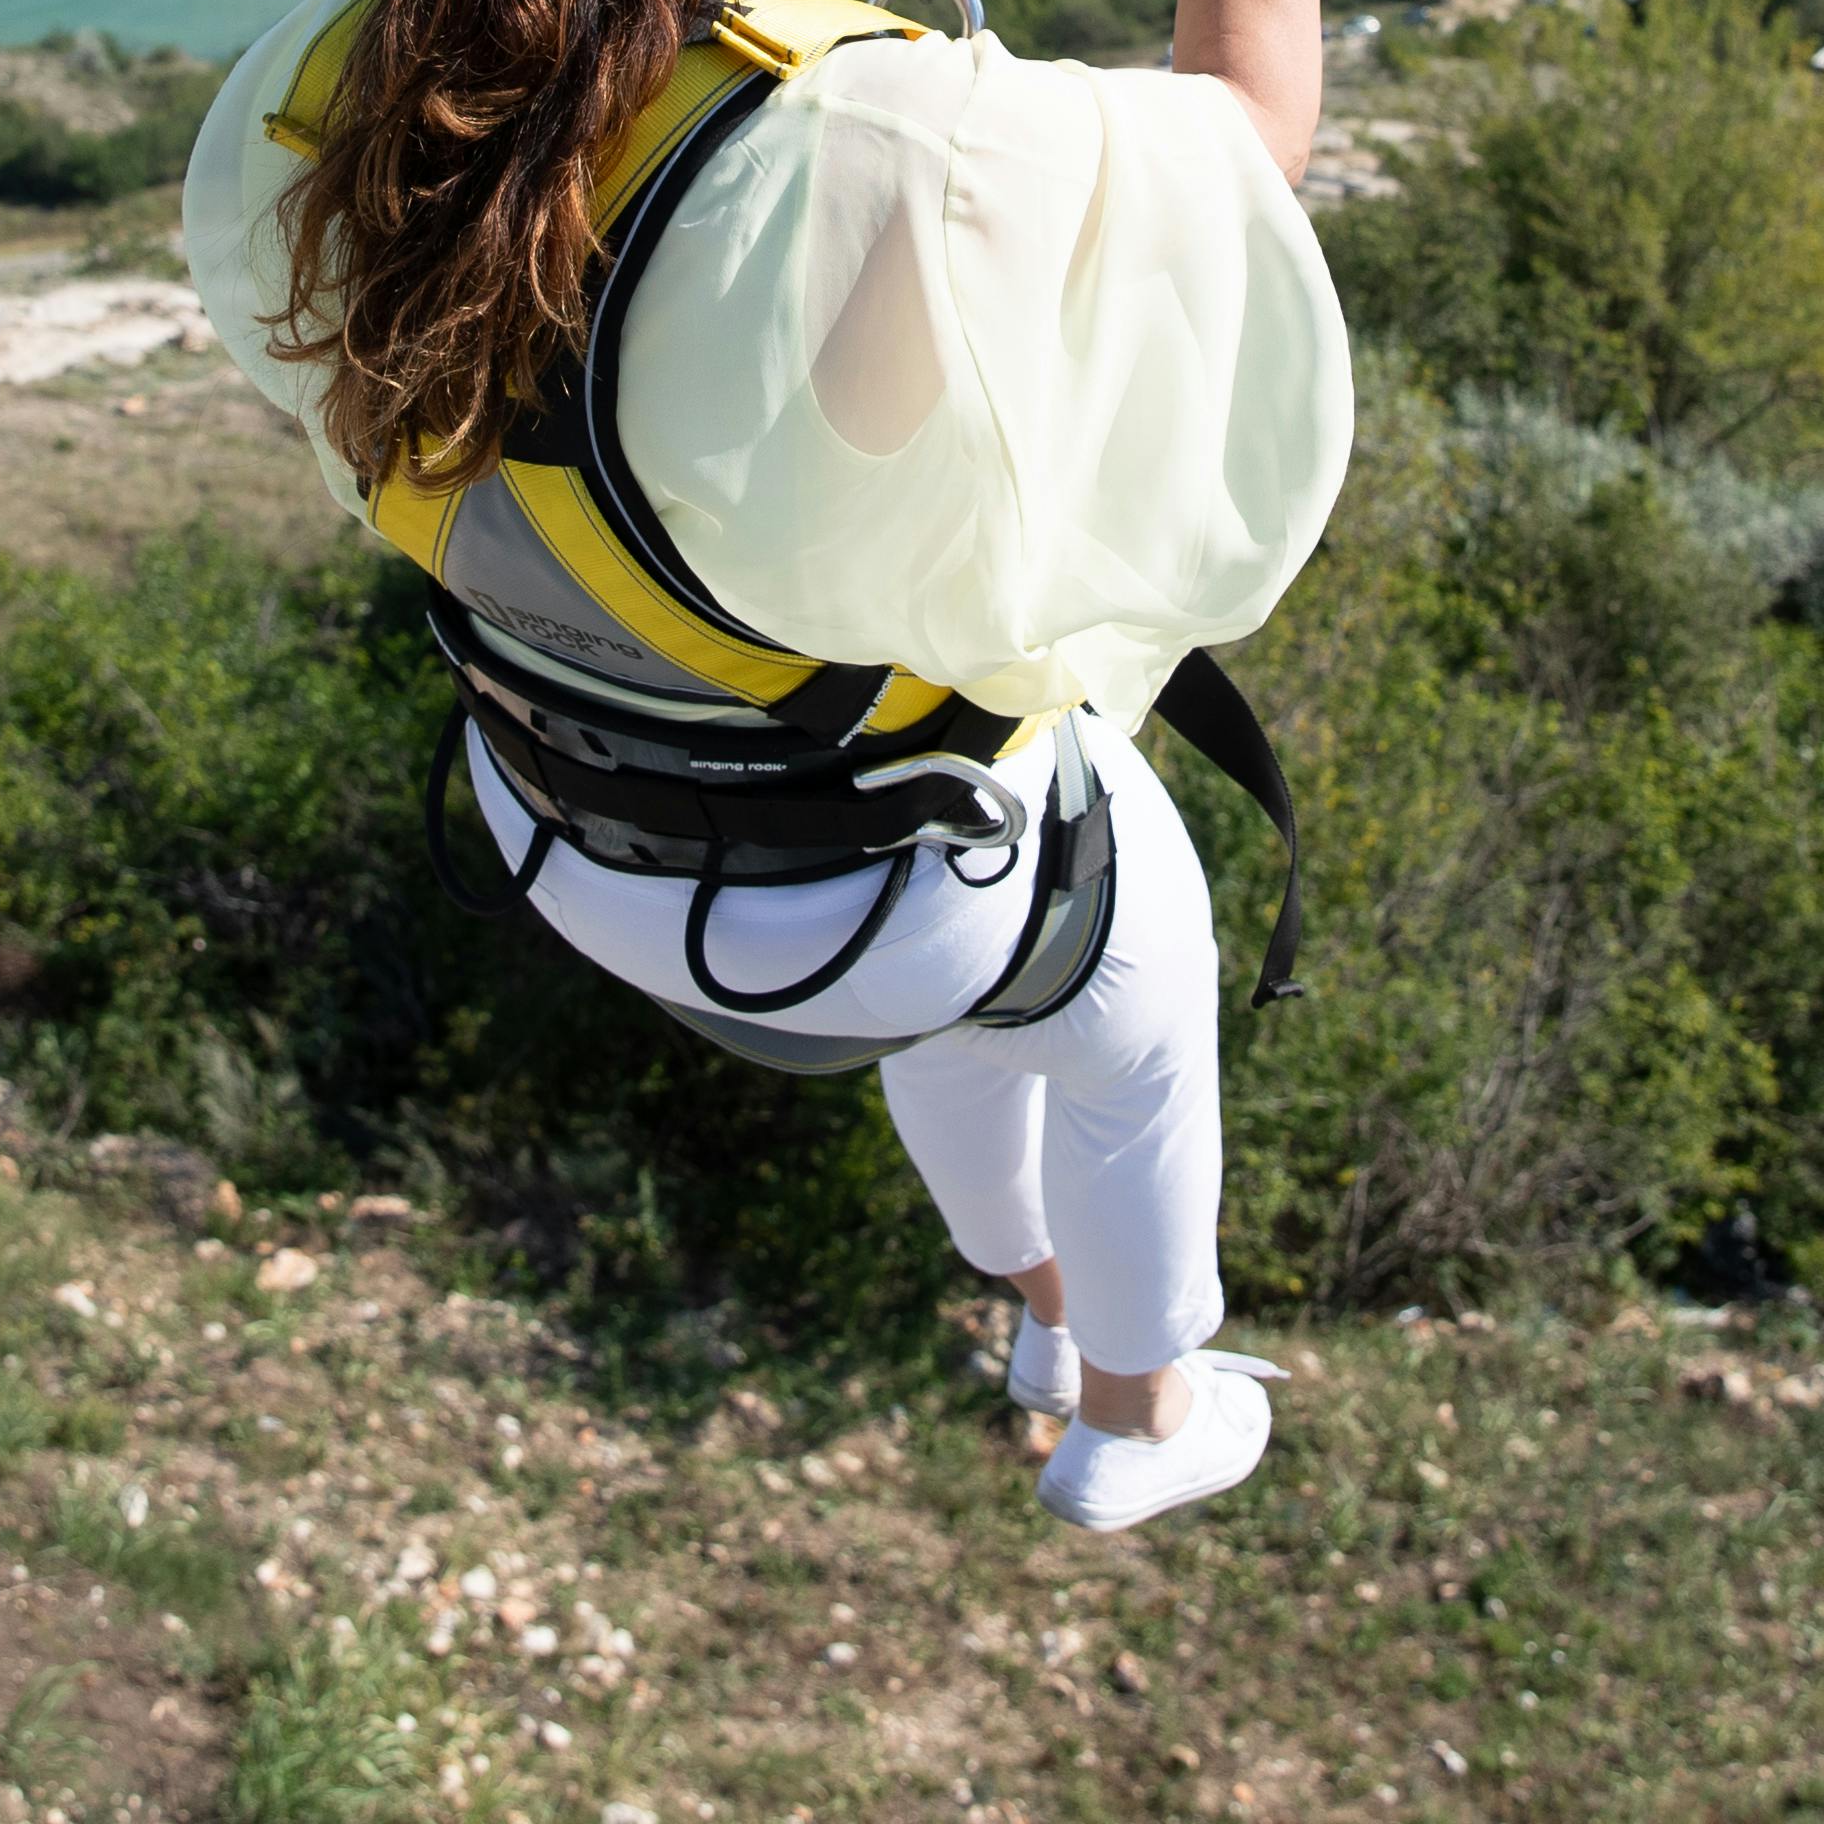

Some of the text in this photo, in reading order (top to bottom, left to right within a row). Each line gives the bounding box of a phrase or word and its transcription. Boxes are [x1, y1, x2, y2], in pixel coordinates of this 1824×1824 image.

[506, 605, 644, 660] singing
[518, 617, 601, 658] rock
[837, 672, 896, 748] singing rock
[689, 760, 782, 771] singing rock
